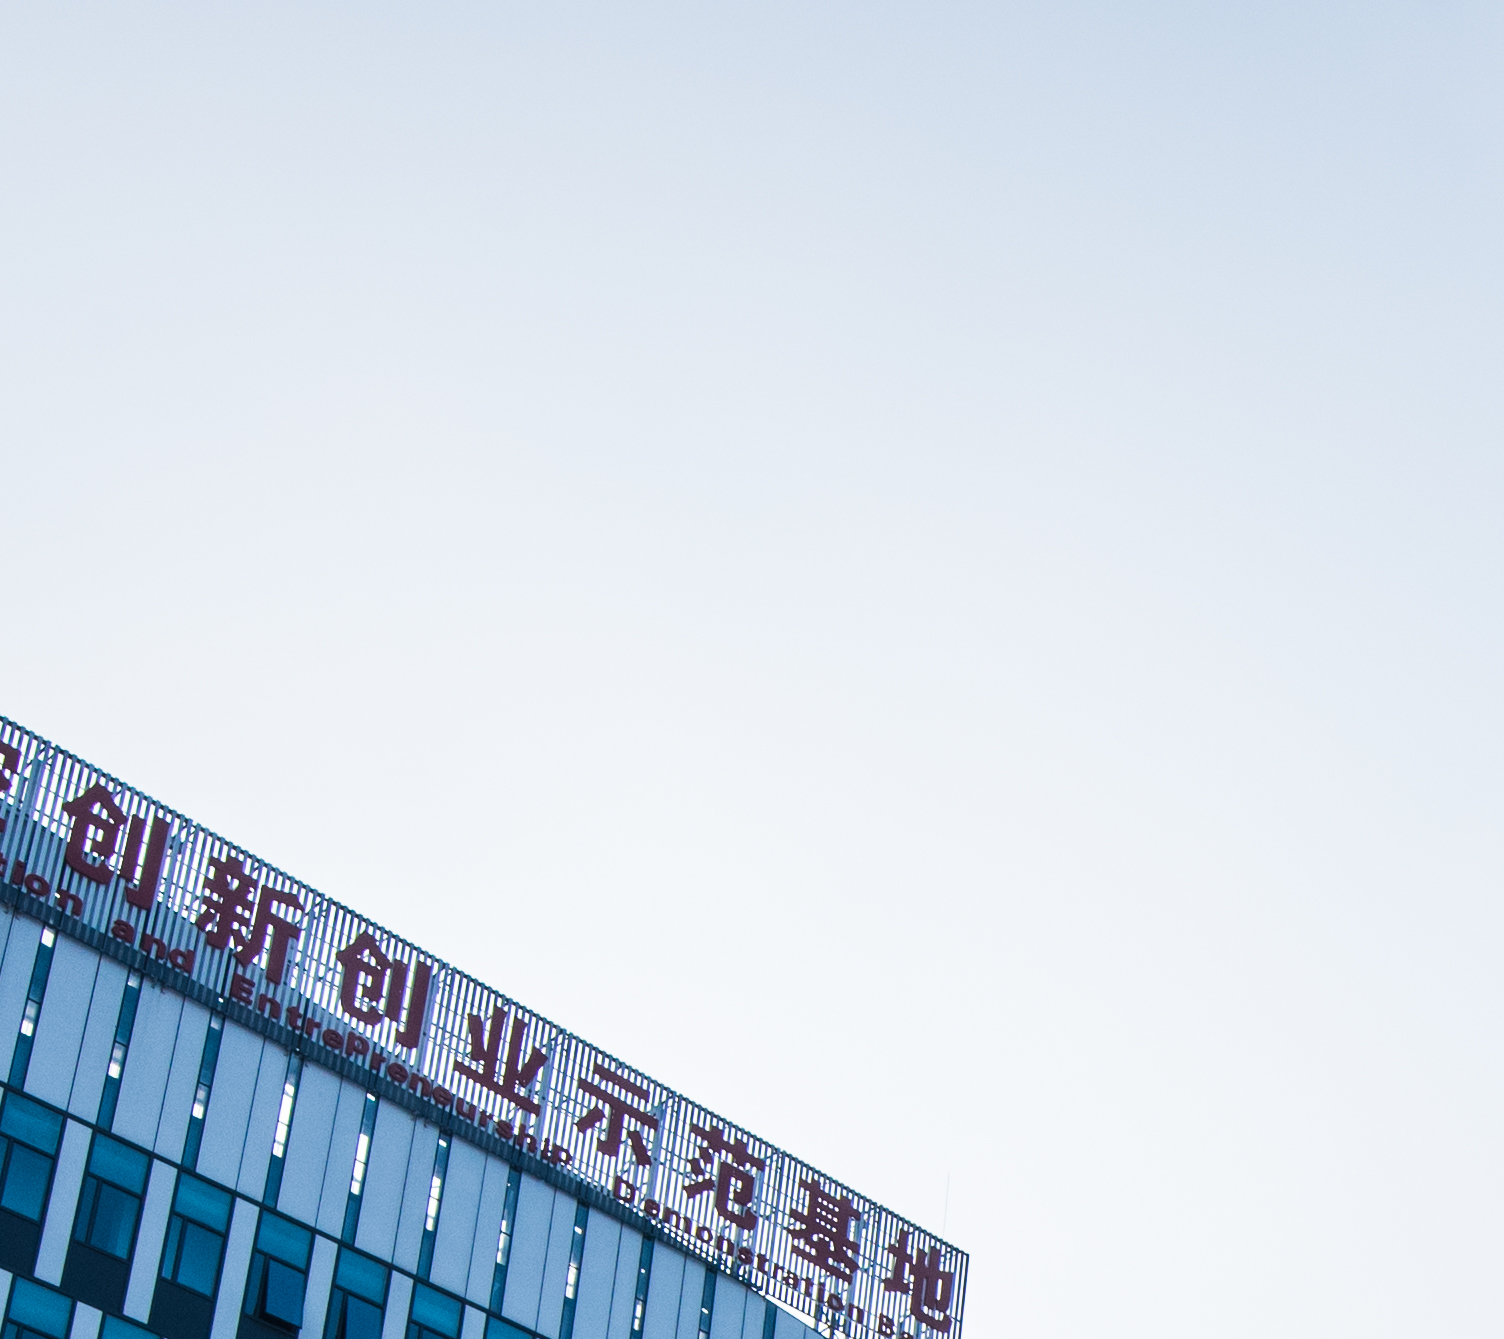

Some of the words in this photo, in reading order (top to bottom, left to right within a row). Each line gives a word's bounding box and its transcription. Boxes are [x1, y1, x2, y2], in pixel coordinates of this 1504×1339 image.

[112, 916, 195, 974] and
[231, 972, 573, 1166] Entrepreneurship
[613, 1175, 865, 1323] Demonstration
